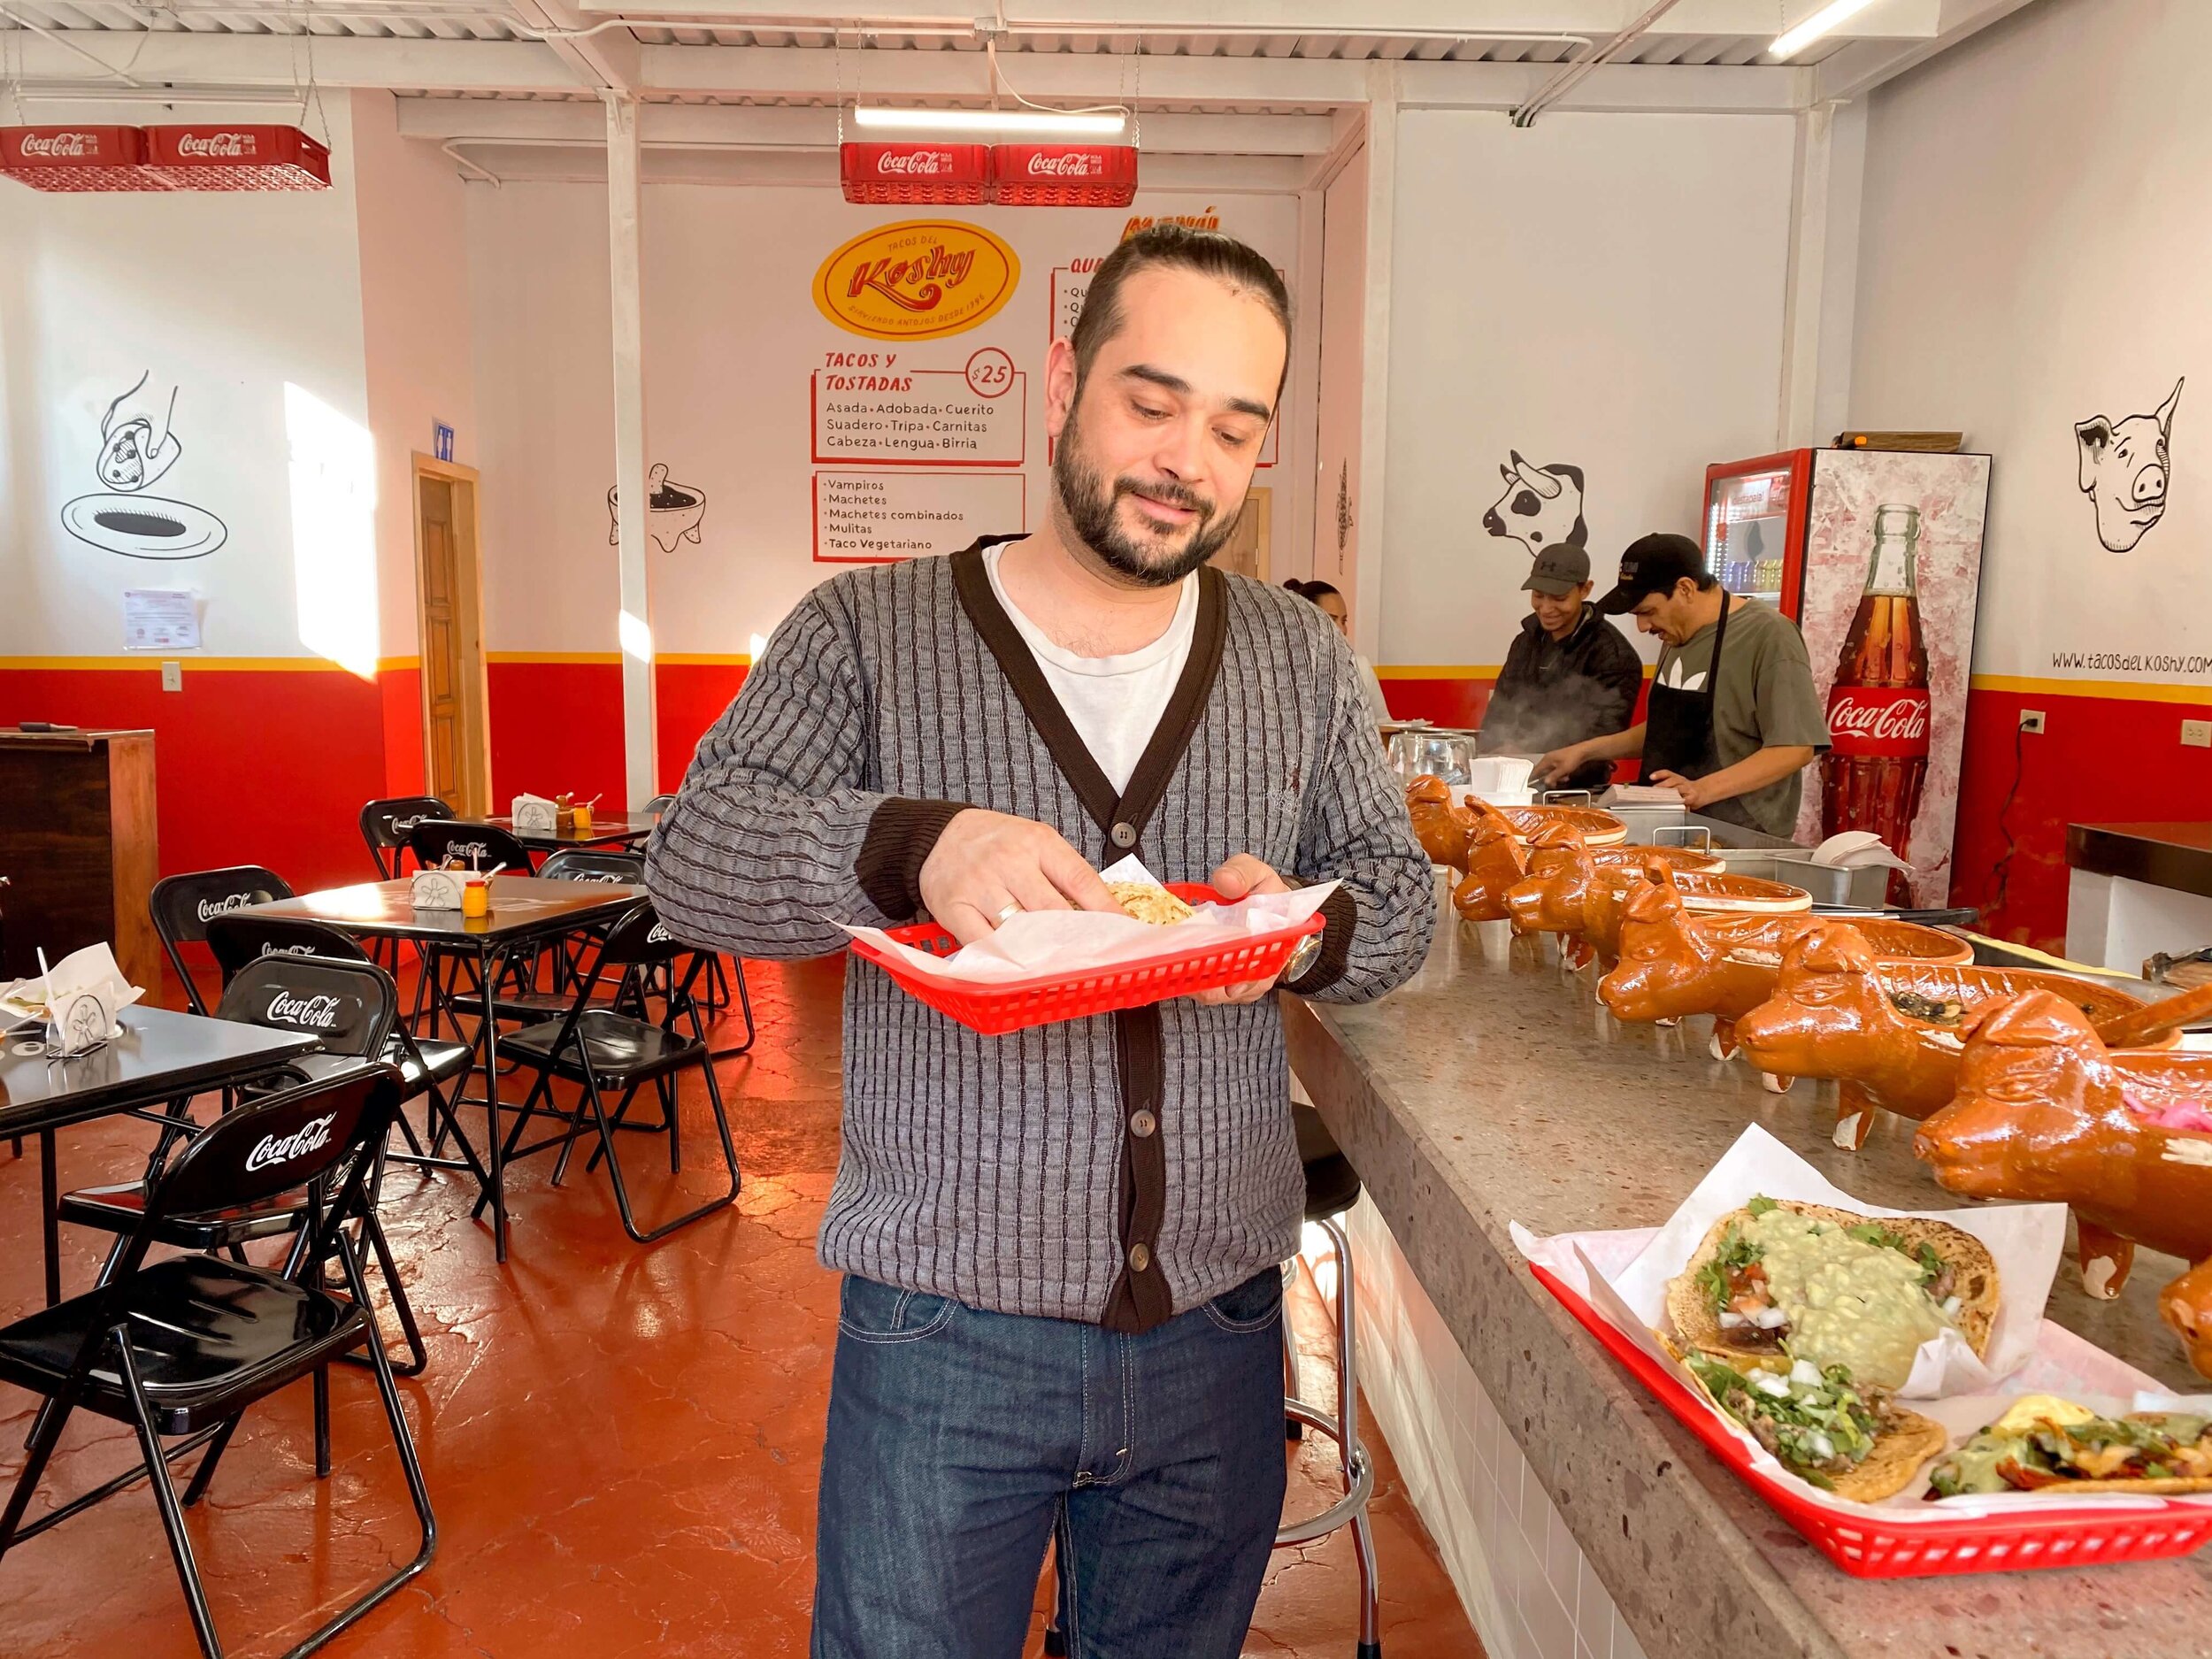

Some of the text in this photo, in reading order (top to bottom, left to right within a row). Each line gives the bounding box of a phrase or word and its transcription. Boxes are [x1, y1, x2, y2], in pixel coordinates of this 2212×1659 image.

[20, 133, 85, 157] Coca-Cola
[177, 133, 243, 157] Coca-Cola
[877, 150, 941, 174] Coca-Cola
[1027, 152, 1089, 176] Coca-Cola
[887, 234, 938, 253] TACOS DEL
[847, 244, 976, 313] Koshy
[897, 316, 936, 327] ANTOJOS
[938, 306, 964, 323] DESDE
[826, 352, 879, 368] TACOS
[826, 375, 912, 392] TOSTADAS
[972, 365, 1007, 384] $25
[826, 402, 995, 416] Asada Adobada Cuerito
[826, 419, 987, 434] Suadero Tripa Carnitas
[826, 436, 978, 451] Cabeza Lengua Birria
[828, 479, 884, 493] Vampiros
[829, 494, 887, 505] Machetes
[829, 509, 964, 521] Machetes combinados
[829, 523, 872, 534] Mulitas
[829, 538, 933, 551] Taco Vegetariano
[1827, 696, 1928, 740] Coca-Cola
[266, 991, 341, 1028] Coca-Cola
[246, 1110, 337, 1172] Coca-Cola
